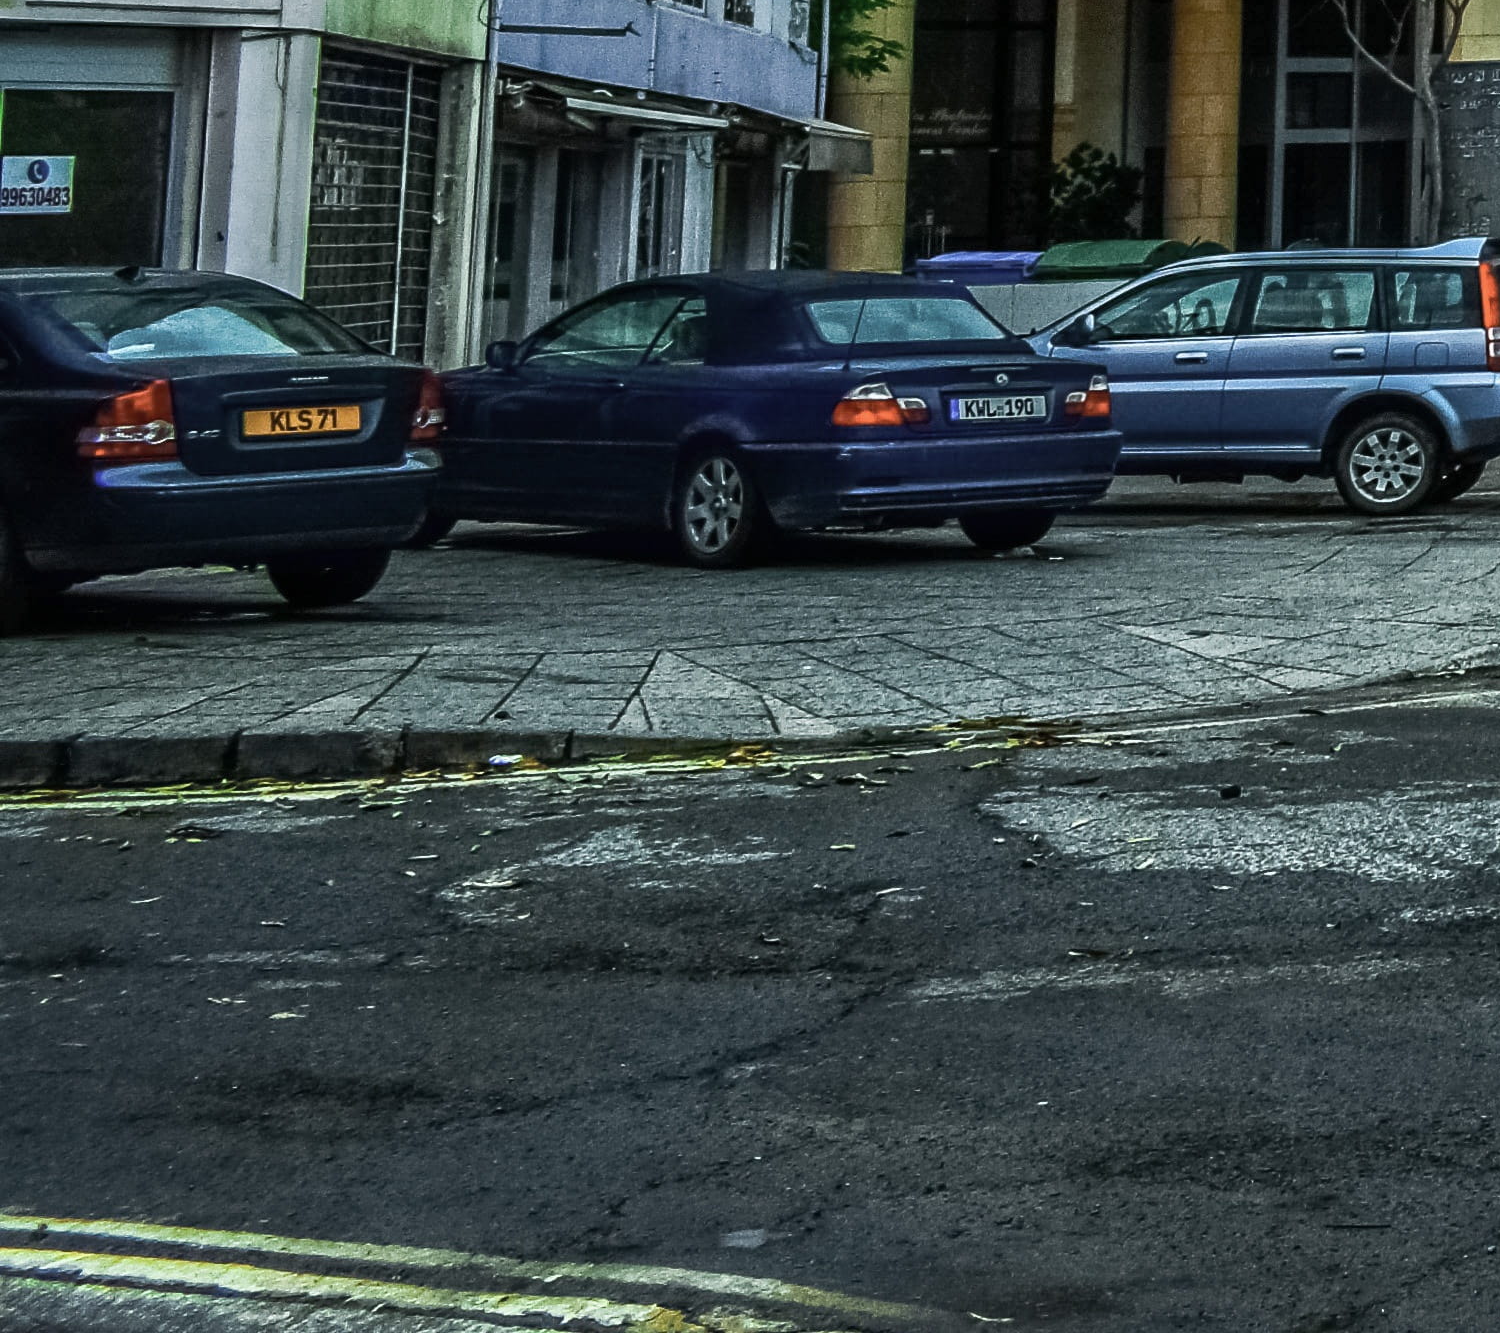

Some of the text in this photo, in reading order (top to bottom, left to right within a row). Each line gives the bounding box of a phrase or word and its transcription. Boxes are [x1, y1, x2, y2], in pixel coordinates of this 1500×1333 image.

[1, 185, 71, 207] 99630483
[964, 398, 1034, 418] KWL 190
[269, 409, 338, 432] KLS 71
